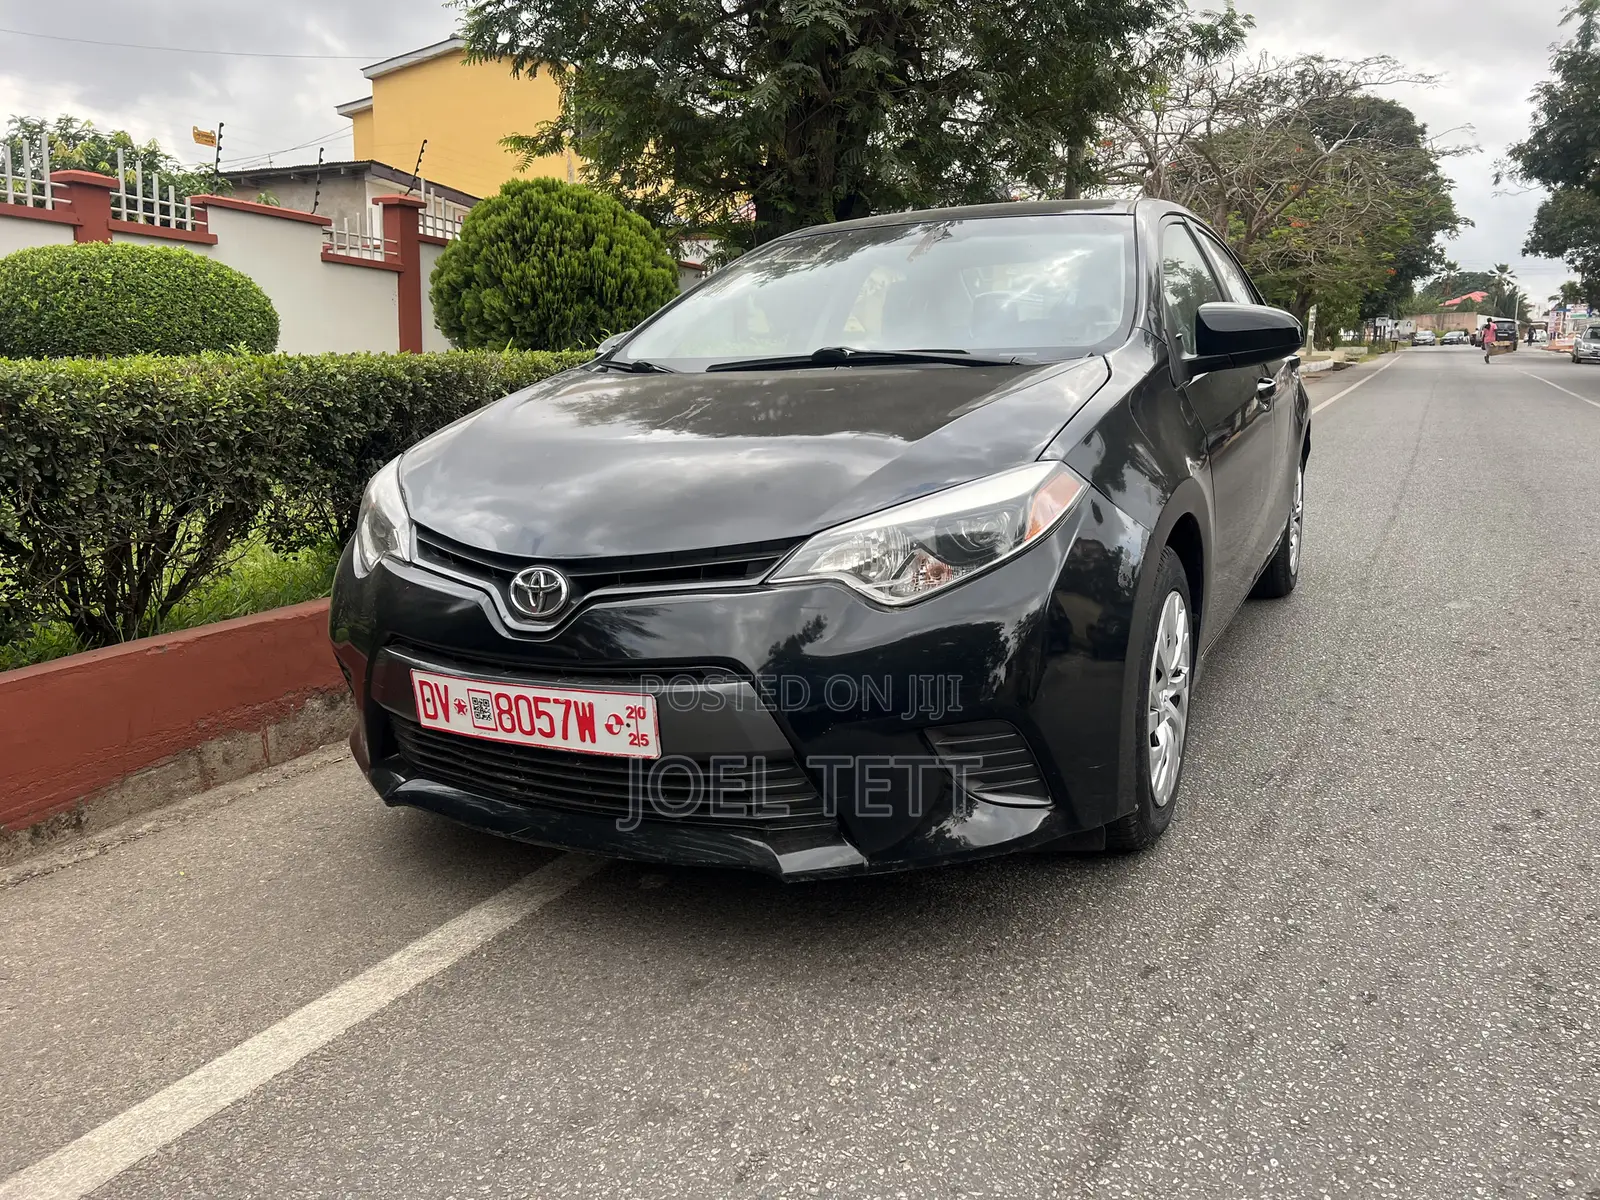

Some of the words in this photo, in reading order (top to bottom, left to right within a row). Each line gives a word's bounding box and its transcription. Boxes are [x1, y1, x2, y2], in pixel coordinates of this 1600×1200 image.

[418, 679, 450, 723] DV
[494, 692, 597, 744] 8057W
[625, 705, 647, 720] 20
[628, 732, 650, 747] 25
